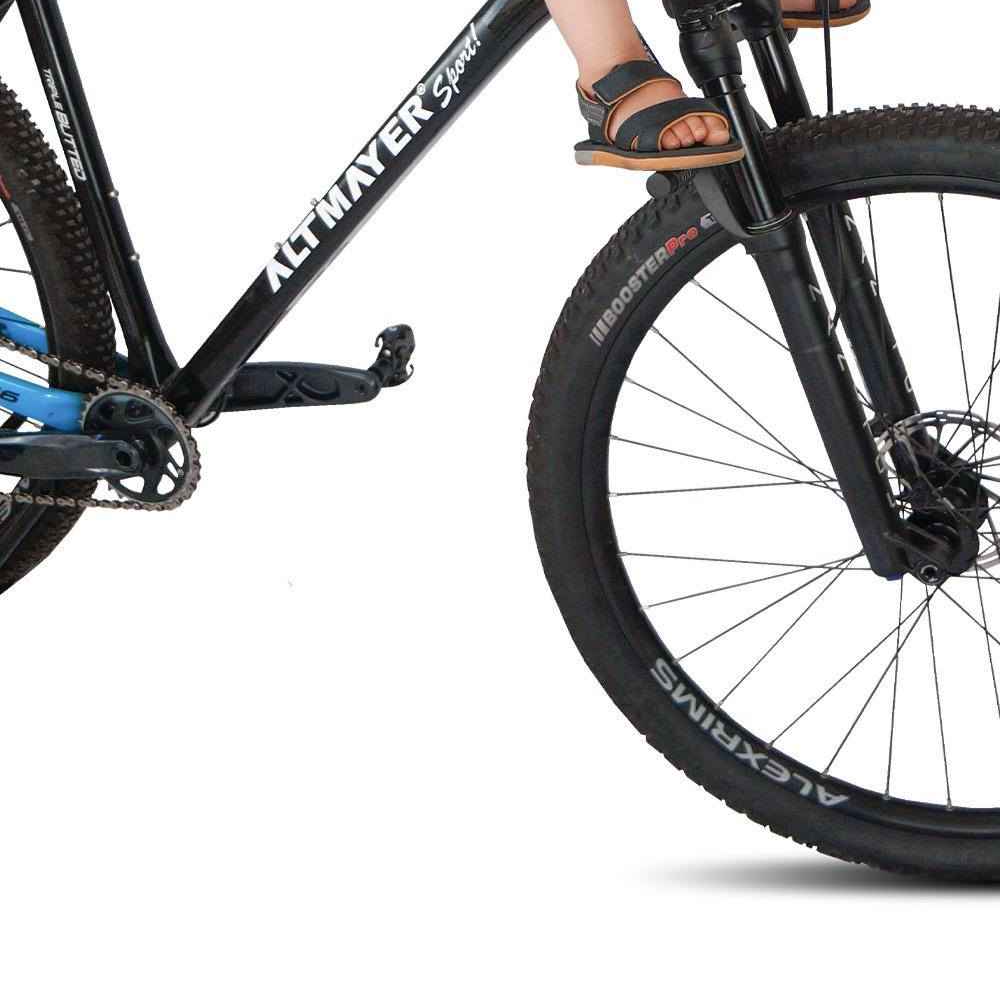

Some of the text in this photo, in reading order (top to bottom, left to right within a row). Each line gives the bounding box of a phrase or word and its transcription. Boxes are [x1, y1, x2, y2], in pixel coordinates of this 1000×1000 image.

[432, 22, 482, 109] Sport!
[43, 67, 87, 181] TRIPLE BUTTED
[650, 657, 850, 807] ALEXRIMS
